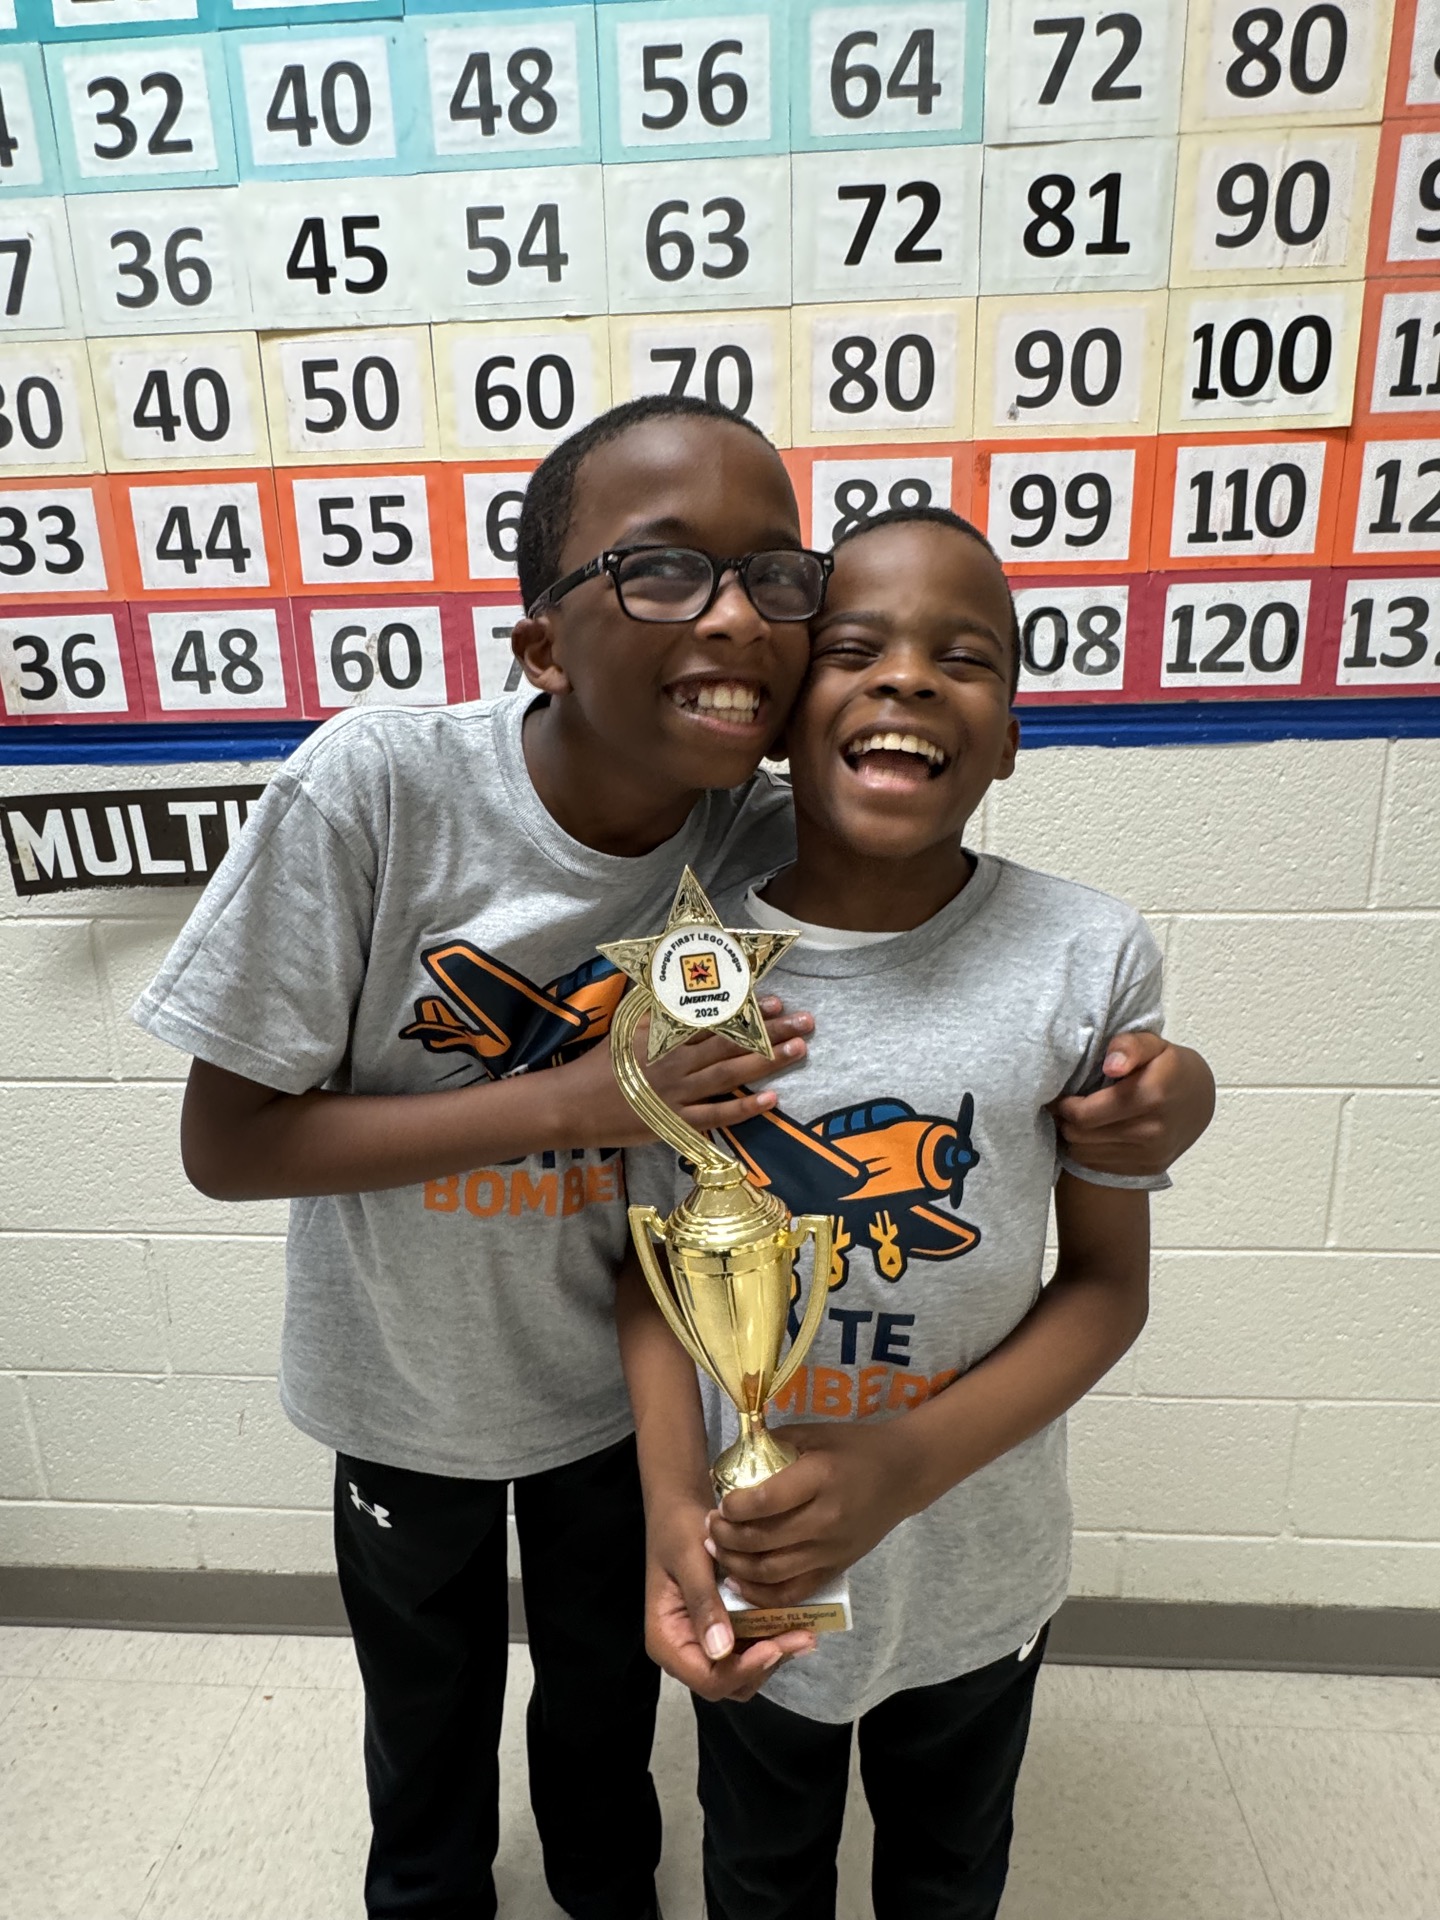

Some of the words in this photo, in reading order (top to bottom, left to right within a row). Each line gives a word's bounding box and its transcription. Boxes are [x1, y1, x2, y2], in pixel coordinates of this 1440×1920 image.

[87, 72, 193, 160] 32
[266, 61, 371, 147] 40
[449, 47, 557, 136] 48
[642, 39, 748, 130] 56
[830, 28, 942, 119] 64
[1033, 12, 1142, 105] 72
[1226, 3, 1348, 99] 80
[110, 227, 212, 308] 36
[286, 215, 388, 295] 45
[466, 204, 569, 286] 54
[646, 197, 749, 282] 63
[837, 181, 943, 266] 72
[1023, 172, 1131, 258] 81
[1215, 160, 1331, 249] 90
[133, 367, 230, 442] 40
[302, 356, 400, 434] 50
[475, 354, 575, 432] 60
[650, 344, 752, 418] 70
[829, 333, 935, 414] 80
[1015, 327, 1122, 409] 90
[1191, 315, 1332, 401] 100
[0, 505, 84, 576] 33
[156, 505, 251, 573] 44
[318, 495, 413, 567] 55
[1010, 472, 1112, 548] 99
[1187, 462, 1307, 544] 110
[12, 633, 106, 701] 36
[171, 628, 264, 695] 48
[330, 622, 423, 692] 60
[1166, 601, 1300, 674] 120
[1343, 596, 1440, 669] 13
[7, 800, 258, 882] MULTI
[659, 950, 673, 982] Georgia
[670, 933, 695, 951] FIRST
[697, 932, 724, 946] LEGO
[723, 943, 743, 973] League
[694, 1006, 719, 1018] 2025
[787, 1307, 915, 1367] TE
